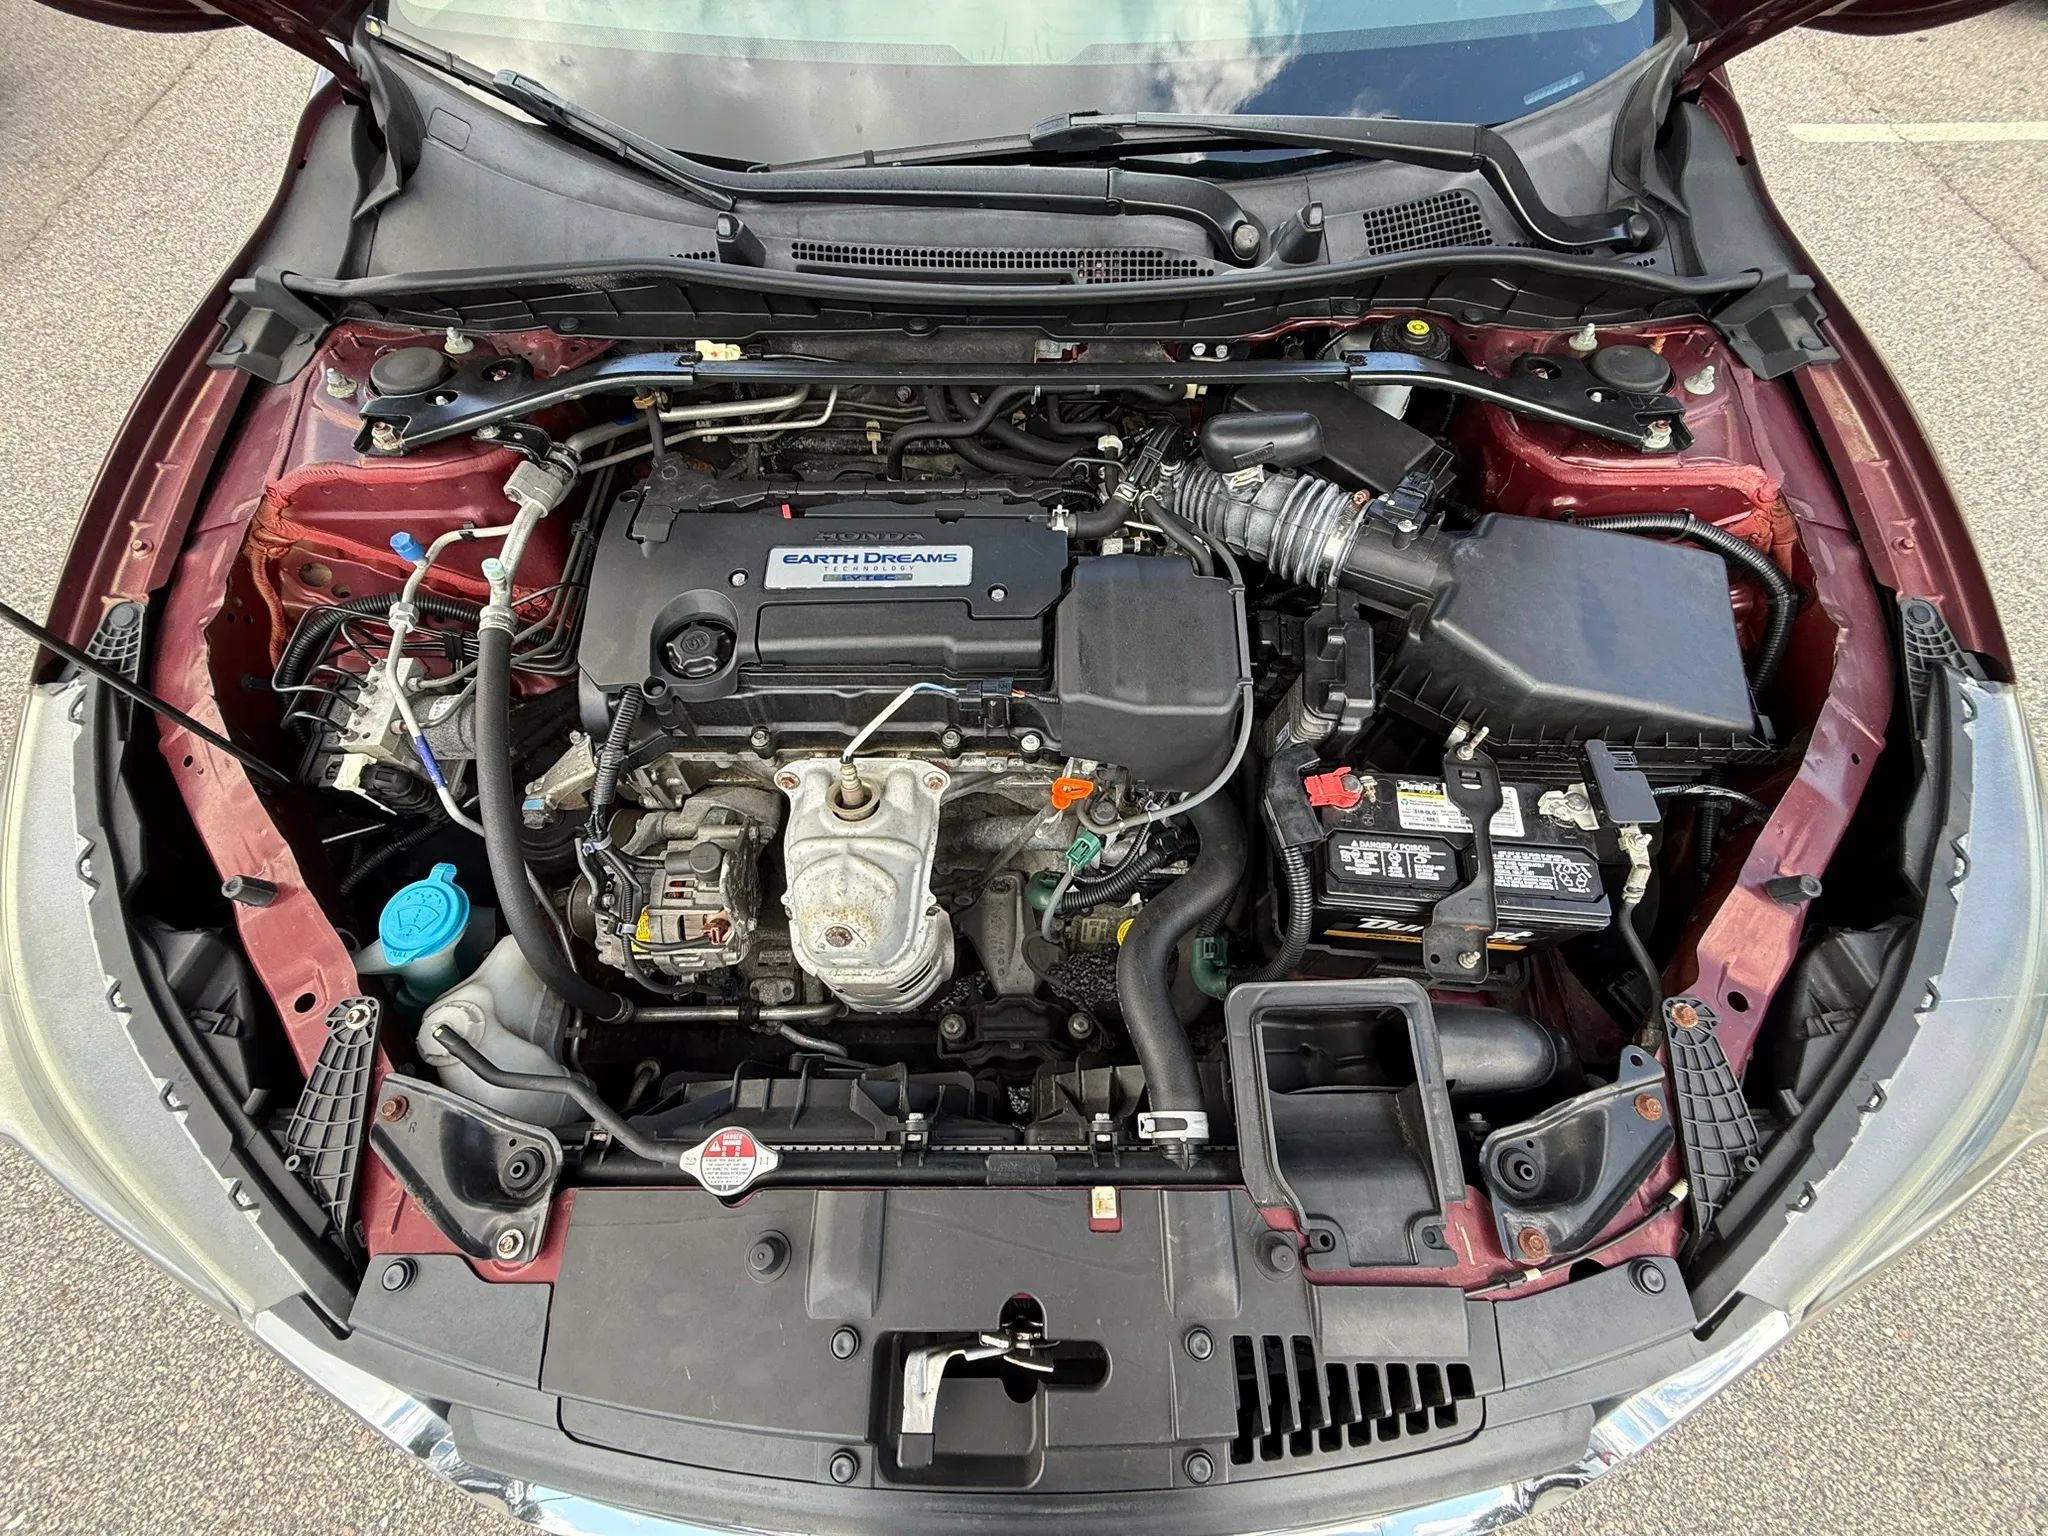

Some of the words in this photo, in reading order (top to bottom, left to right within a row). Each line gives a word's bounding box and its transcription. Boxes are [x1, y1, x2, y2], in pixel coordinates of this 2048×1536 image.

[815, 530, 926, 542] HONDA
[782, 553, 859, 565] EARTH
[863, 552, 958, 565] DREAMS
[824, 565, 915, 573] TECHNOLOGY
[1359, 840, 1392, 851] DANGER
[1399, 843, 1430, 853] POISON
[407, 1121, 418, 1134] R
